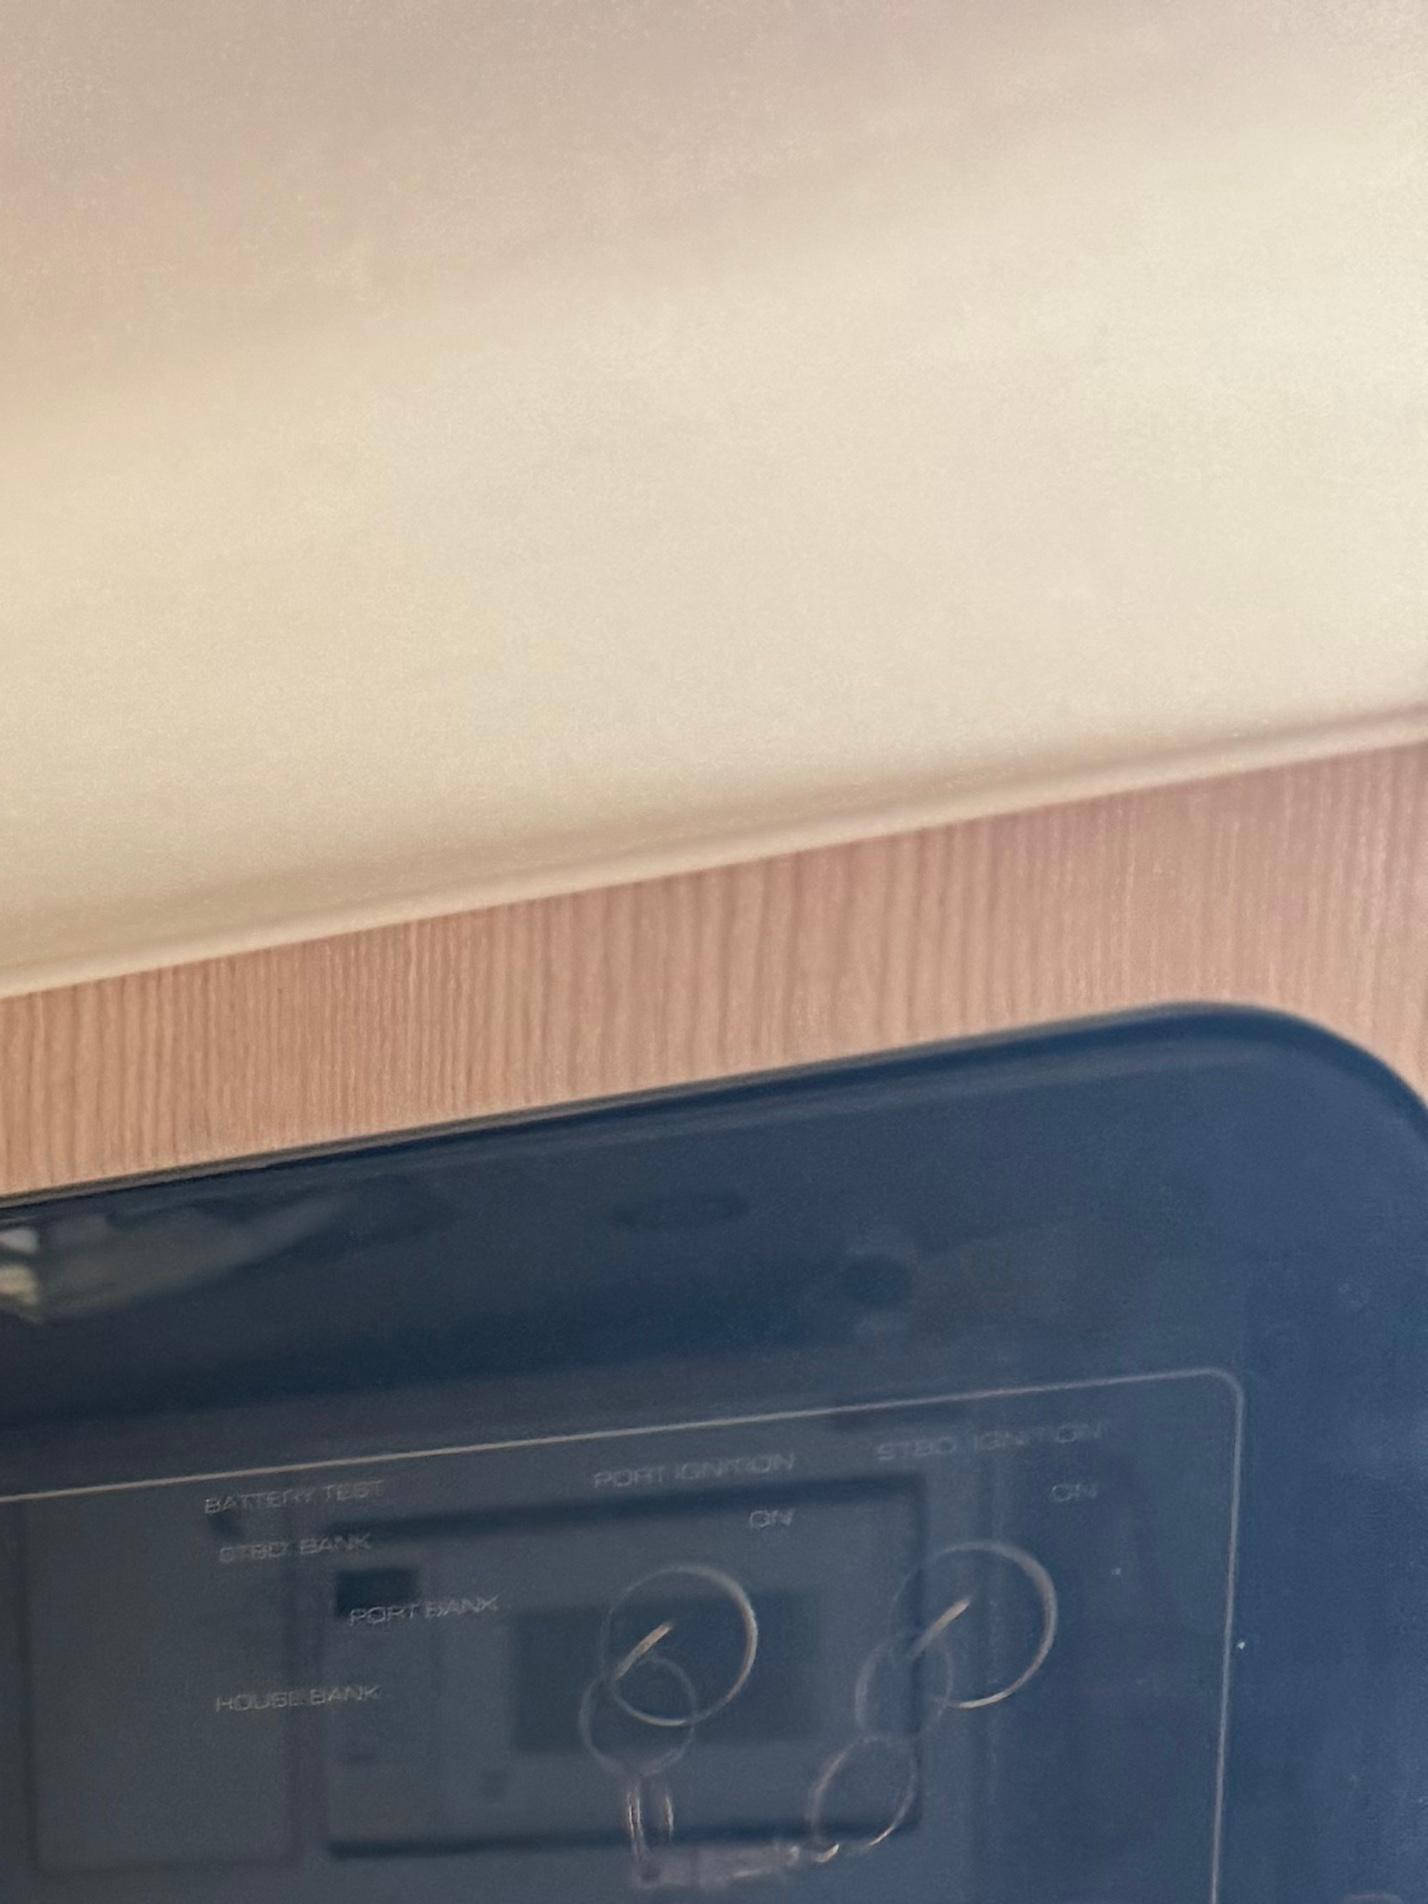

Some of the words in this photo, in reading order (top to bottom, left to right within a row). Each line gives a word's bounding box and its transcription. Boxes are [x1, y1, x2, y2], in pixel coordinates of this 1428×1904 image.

[593, 1467, 665, 1489] PORT
[204, 1488, 313, 1515] BATTERY
[325, 1479, 385, 1501] TEST
[749, 1509, 795, 1529] ON
[300, 1533, 372, 1556] BANK
[349, 1603, 418, 1627] PORT
[425, 1595, 498, 1619] BANK
[216, 1689, 300, 1713] HOUSE
[310, 1684, 383, 1706] BANK
